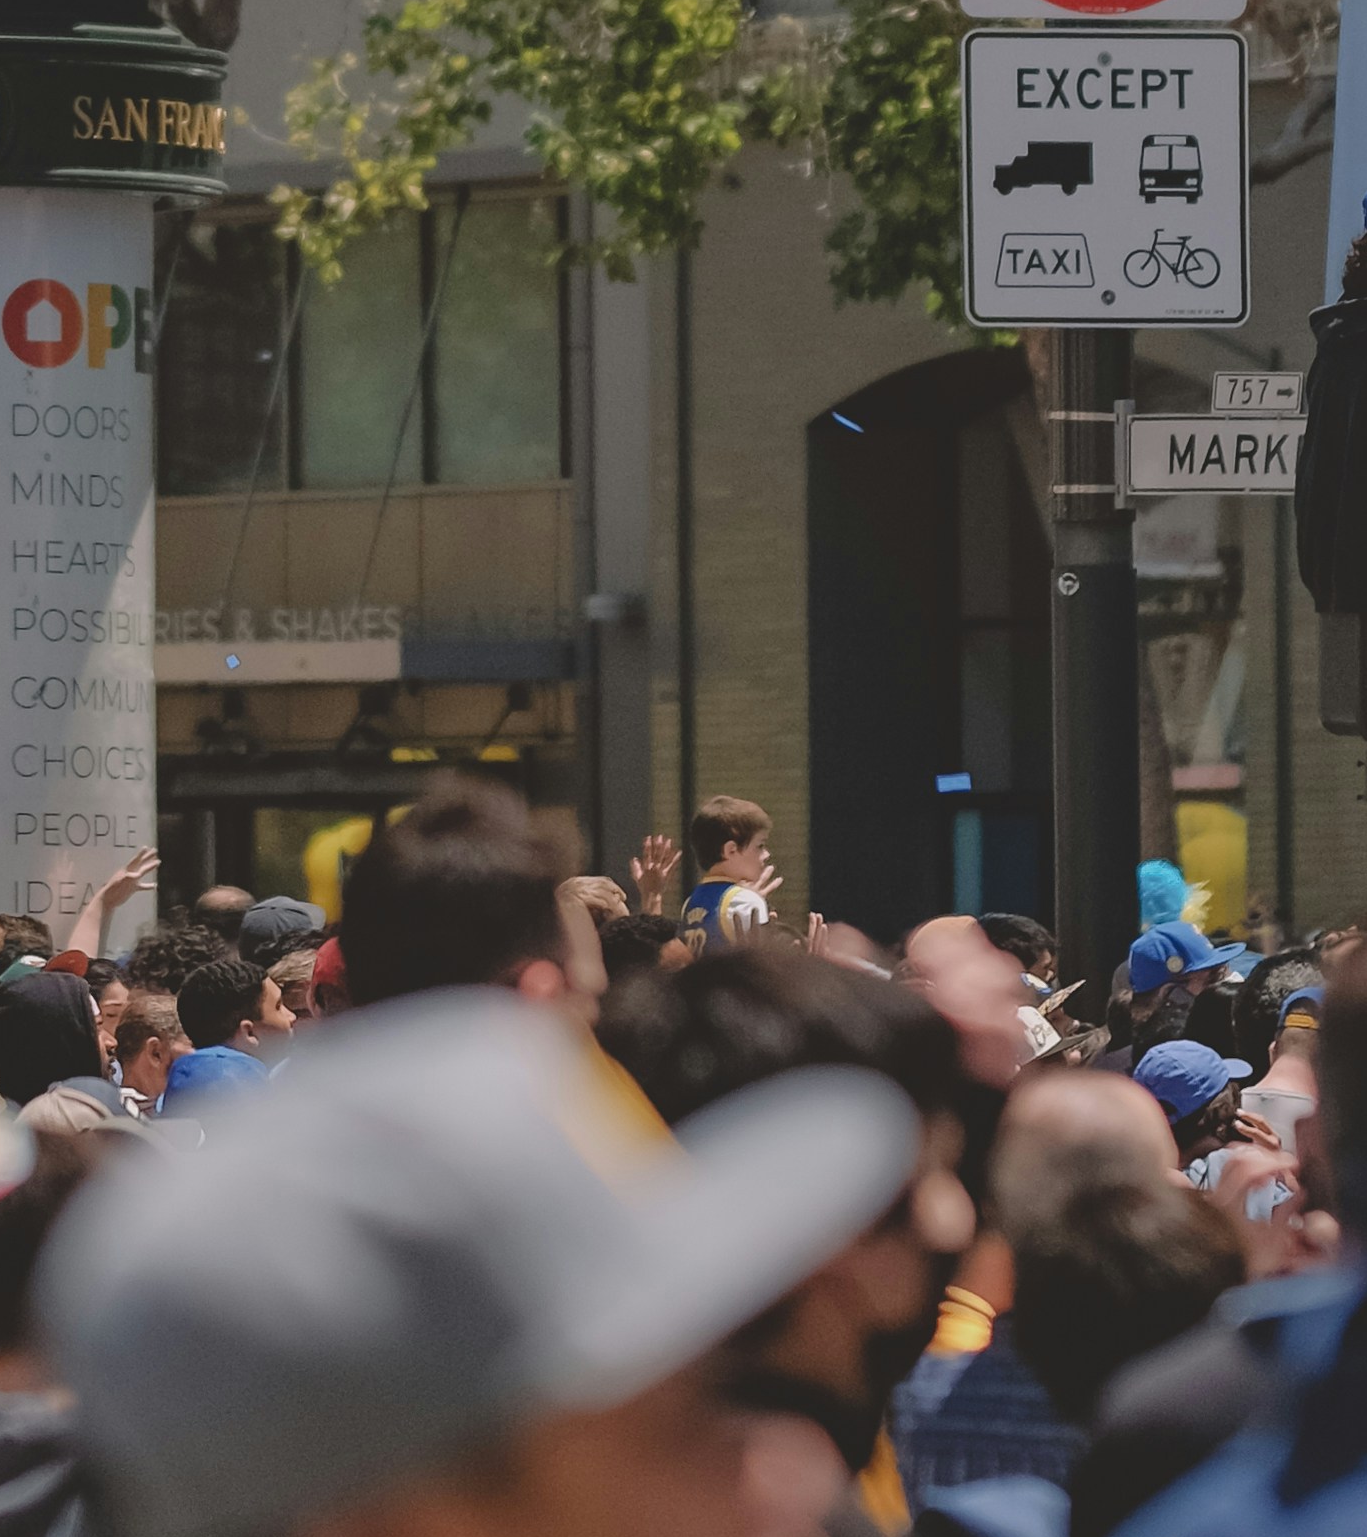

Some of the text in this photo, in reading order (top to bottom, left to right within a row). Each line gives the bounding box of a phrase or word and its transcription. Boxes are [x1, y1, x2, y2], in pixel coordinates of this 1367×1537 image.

[1016, 67, 1194, 110] EXCEPT
[72, 95, 150, 143] SAN
[1006, 249, 1081, 275] TAXI
[1228, 378, 1270, 405] 757
[12, 403, 131, 442] DOORS
[12, 472, 124, 508] MINDS
[12, 539, 136, 577] HEARTS
[13, 607, 153, 646] POSSIBIL
[11, 743, 146, 781] CHOICES
[15, 812, 137, 848] PEOPLE
[14, 880, 107, 915] IDEA
